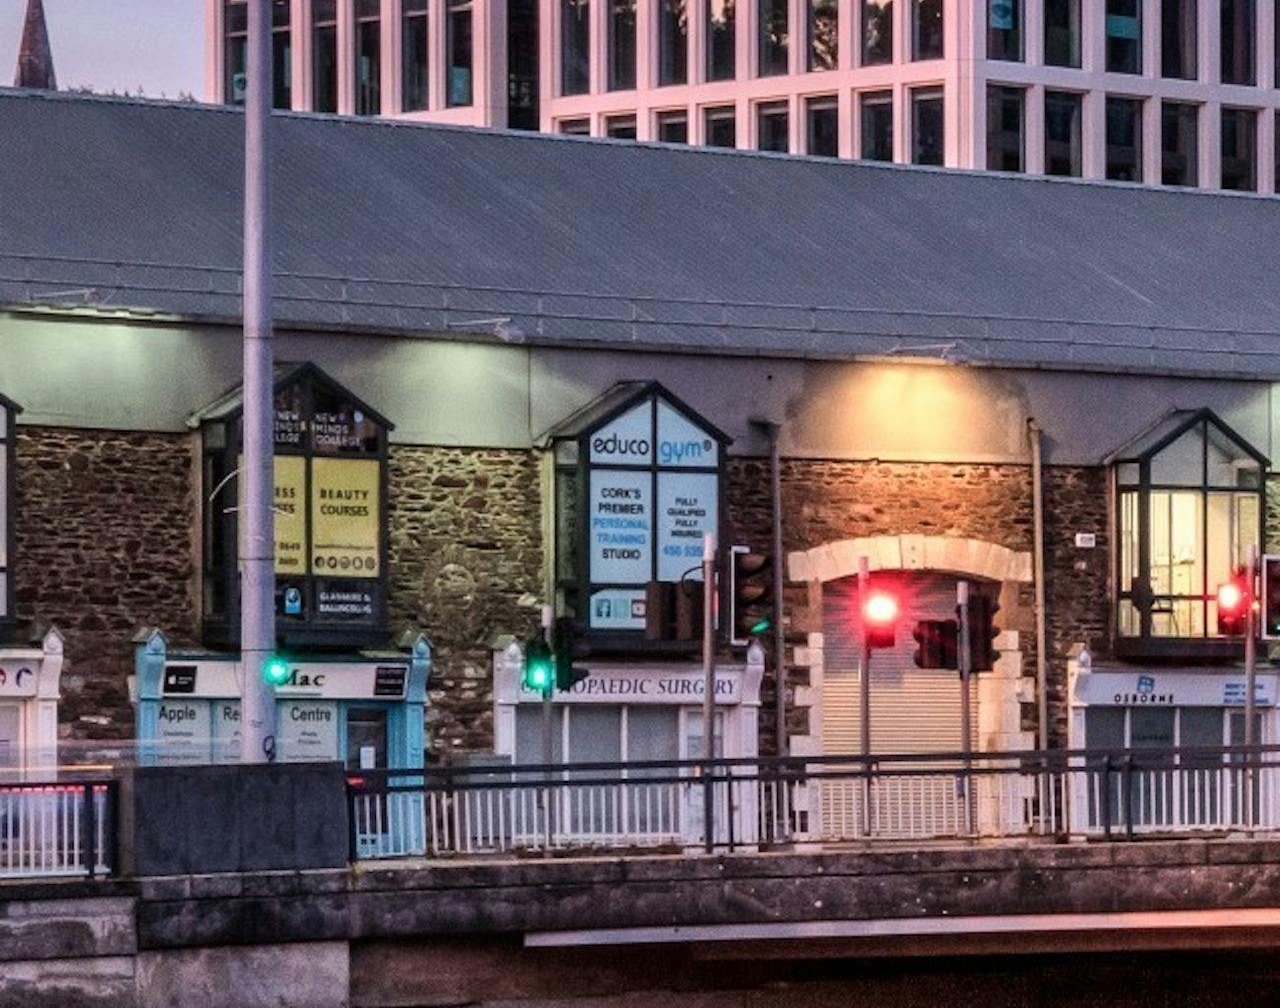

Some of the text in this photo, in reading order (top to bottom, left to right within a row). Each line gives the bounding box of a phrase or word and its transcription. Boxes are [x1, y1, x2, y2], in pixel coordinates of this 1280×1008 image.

[593, 433, 649, 455] educo
[320, 488, 369, 500] BEAUTY
[600, 487, 642, 499] CORK'S
[674, 497, 698, 506] FULLY
[320, 504, 369, 516] COURSES
[598, 502, 644, 514] PREMIER
[593, 518, 649, 530] PERSONAL
[597, 533, 646, 545] TRAINING
[601, 548, 642, 560] STUDIO
[522, 678, 736, 694] OPAEDIC SURGRY
[1114, 693, 1174, 703] OSBORNE
[159, 704, 331, 723] Apple Centre
